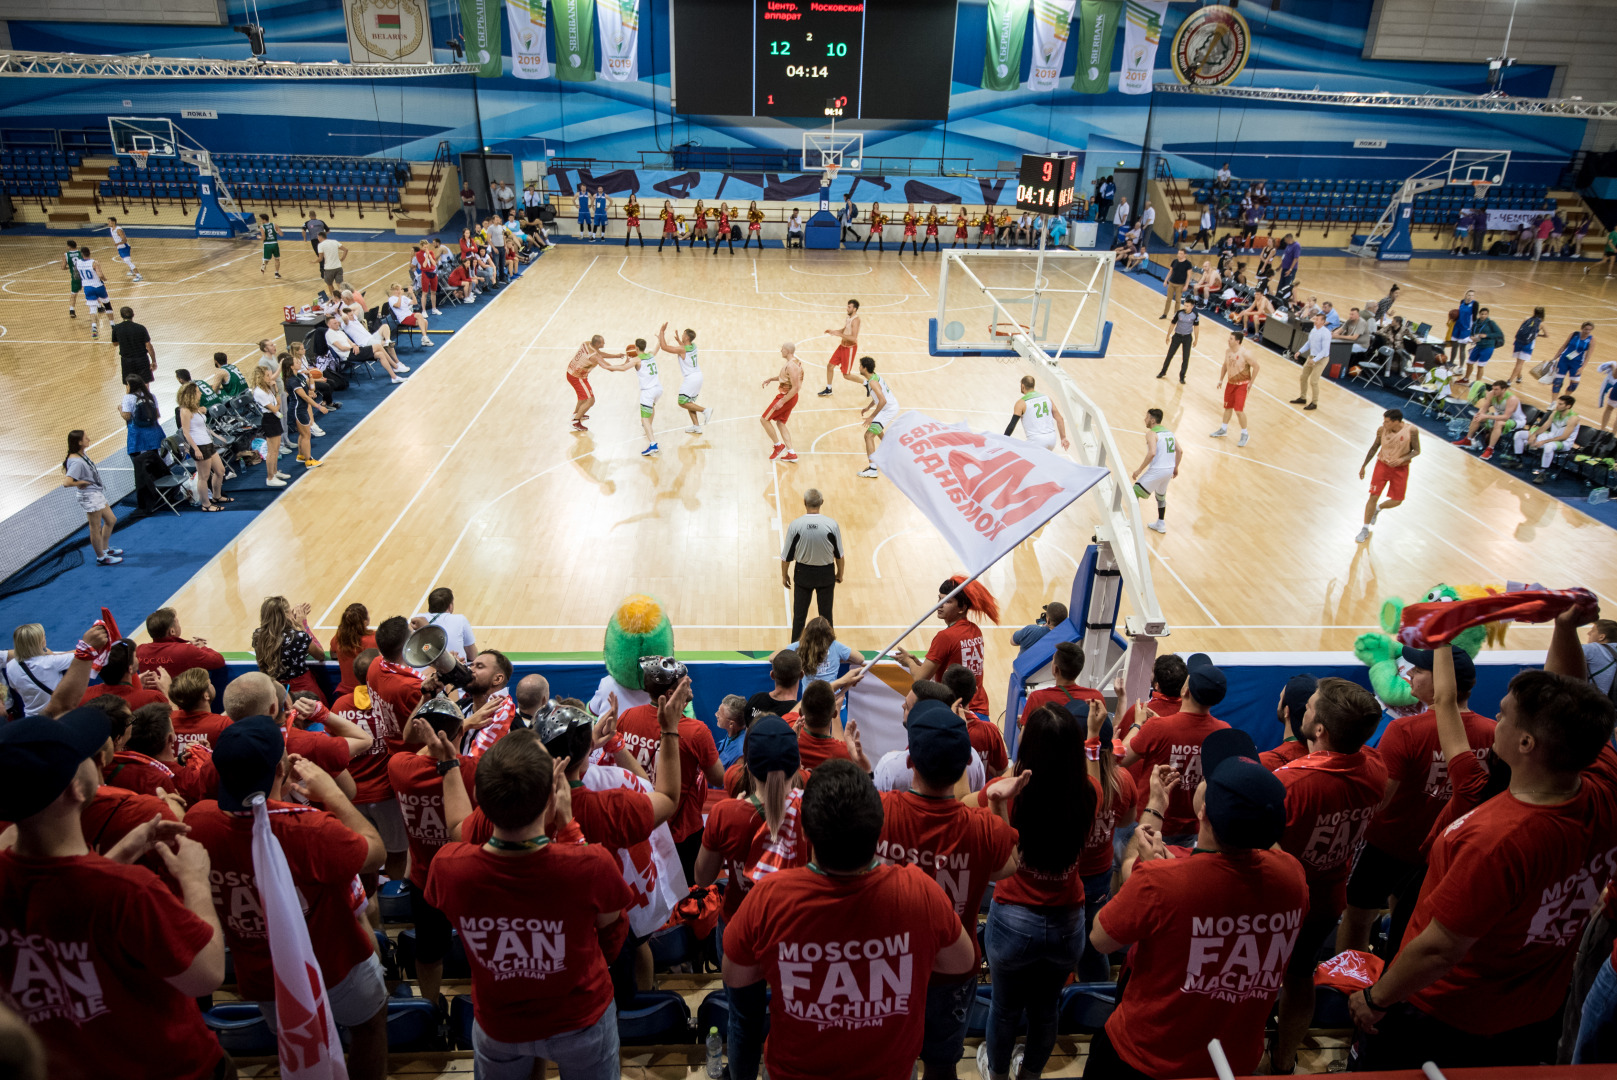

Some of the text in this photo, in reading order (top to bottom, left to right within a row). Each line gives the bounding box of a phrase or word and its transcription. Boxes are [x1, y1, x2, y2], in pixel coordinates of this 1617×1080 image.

[810, 2, 864, 12] Московский
[764, 12, 802, 21] аппарат
[806, 32, 813, 41] 2
[1090, 14, 1104, 65] SBERBANK
[770, 41, 847, 57] 12 10
[518, 55, 540, 65] 2019
[608, 59, 631, 68] 2019
[786, 65, 828, 78] 04:14
[1035, 68, 1057, 78] 2019
[1125, 71, 1147, 81] 2019
[767, 94, 774, 104] 1
[1042, 161, 1053, 182] 9
[1016, 184, 1055, 207] 04:14
[822, 202, 828, 211] 2
[267, 229, 275, 238] 2
[80, 269, 93, 280] 10
[285, 309, 291, 321] 5
[290, 308, 296, 320] 5
[647, 362, 658, 375] 33
[1033, 401, 1049, 418] 24
[1165, 437, 1175, 453] 12
[400, 803, 446, 830] FA
[876, 840, 970, 870] MOSCOW
[460, 916, 564, 933] MOSCOW
[1191, 908, 1302, 937] MOSCOW
[461, 930, 566, 962] FAN
[778, 931, 910, 962] MOSCOW
[1186, 927, 1301, 977] FAN
[517, 970, 546, 980] TEAM
[777, 953, 913, 1005] FAN
[1183, 970, 1281, 992] MACHIN
[783, 994, 909, 1020] MACHINE
[817, 1018, 883, 1032] FAN TEAM
